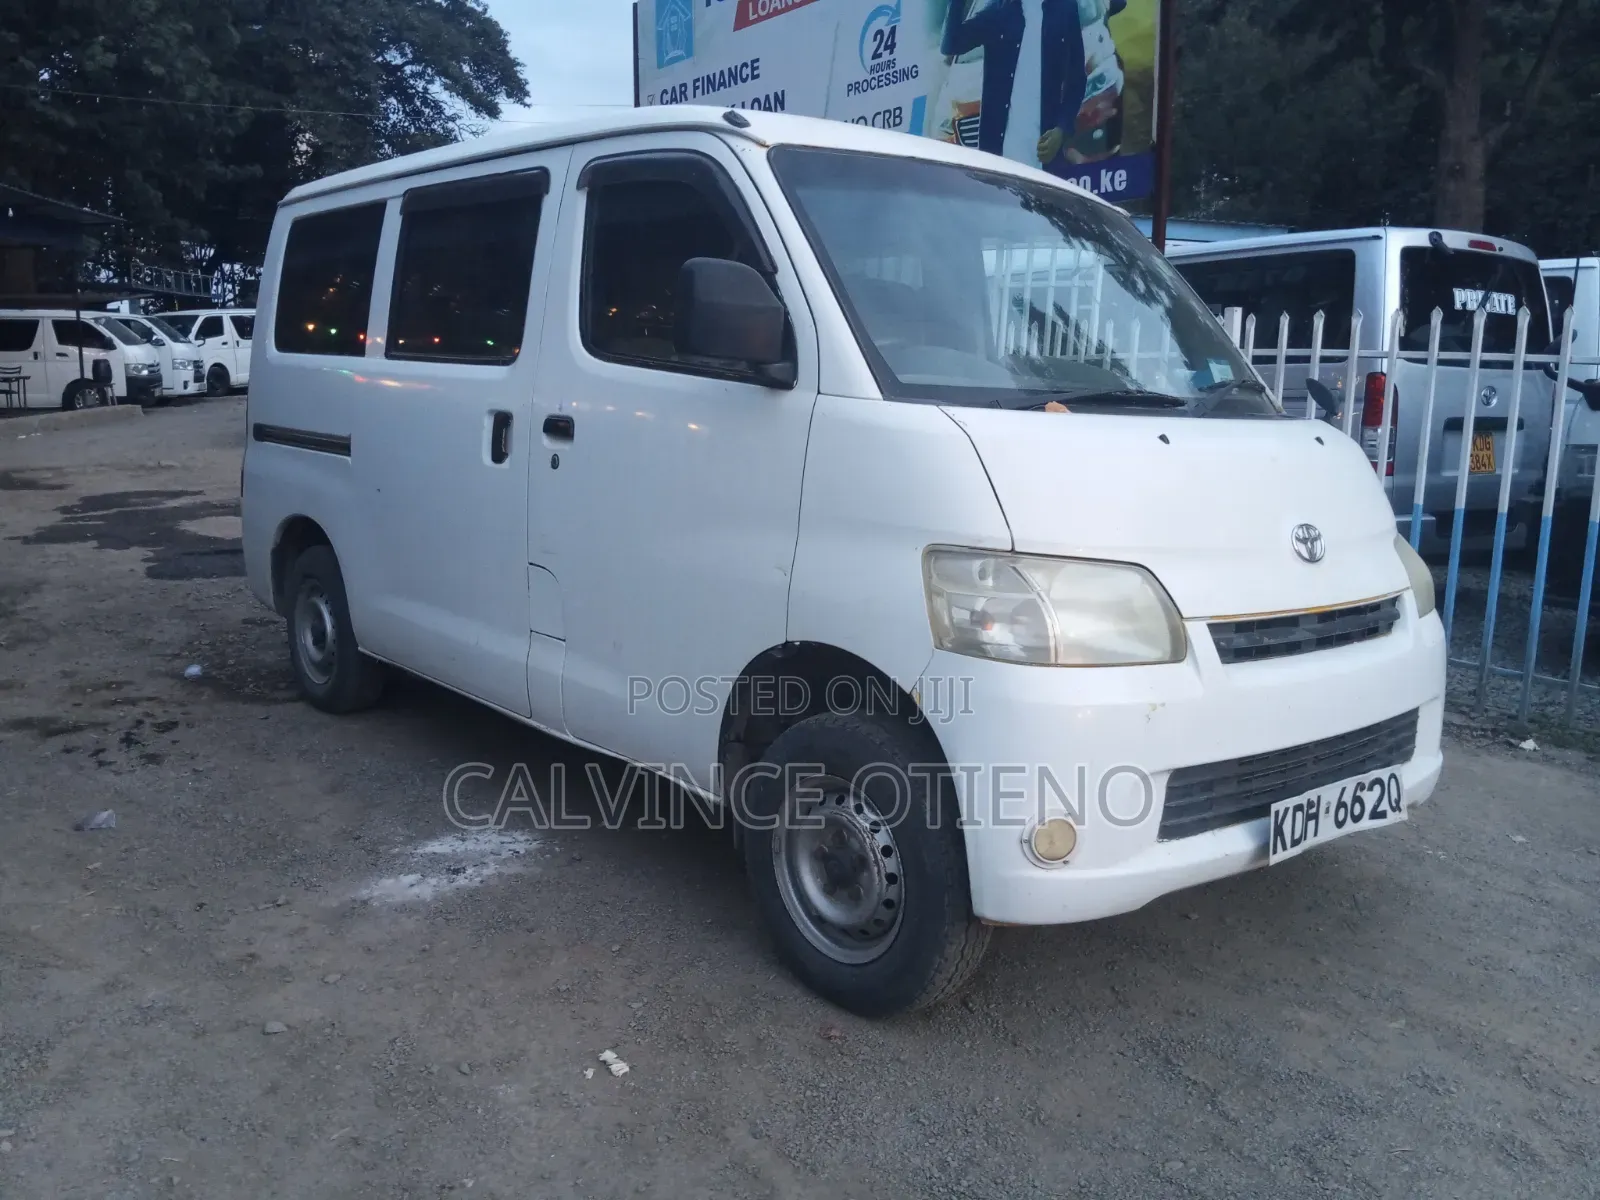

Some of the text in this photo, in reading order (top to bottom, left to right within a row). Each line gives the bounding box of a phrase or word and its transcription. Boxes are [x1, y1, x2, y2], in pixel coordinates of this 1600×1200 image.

[871, 25, 897, 60] 24
[869, 58, 897, 75] HOURS
[660, 58, 760, 105] CAR FINANCE
[847, 65, 919, 97] PROCESSING
[872, 106, 903, 129] CRB
[1472, 435, 1491, 451] KDG
[1470, 453, 1493, 470] 384X
[1272, 773, 1402, 855] KDH 662Q
